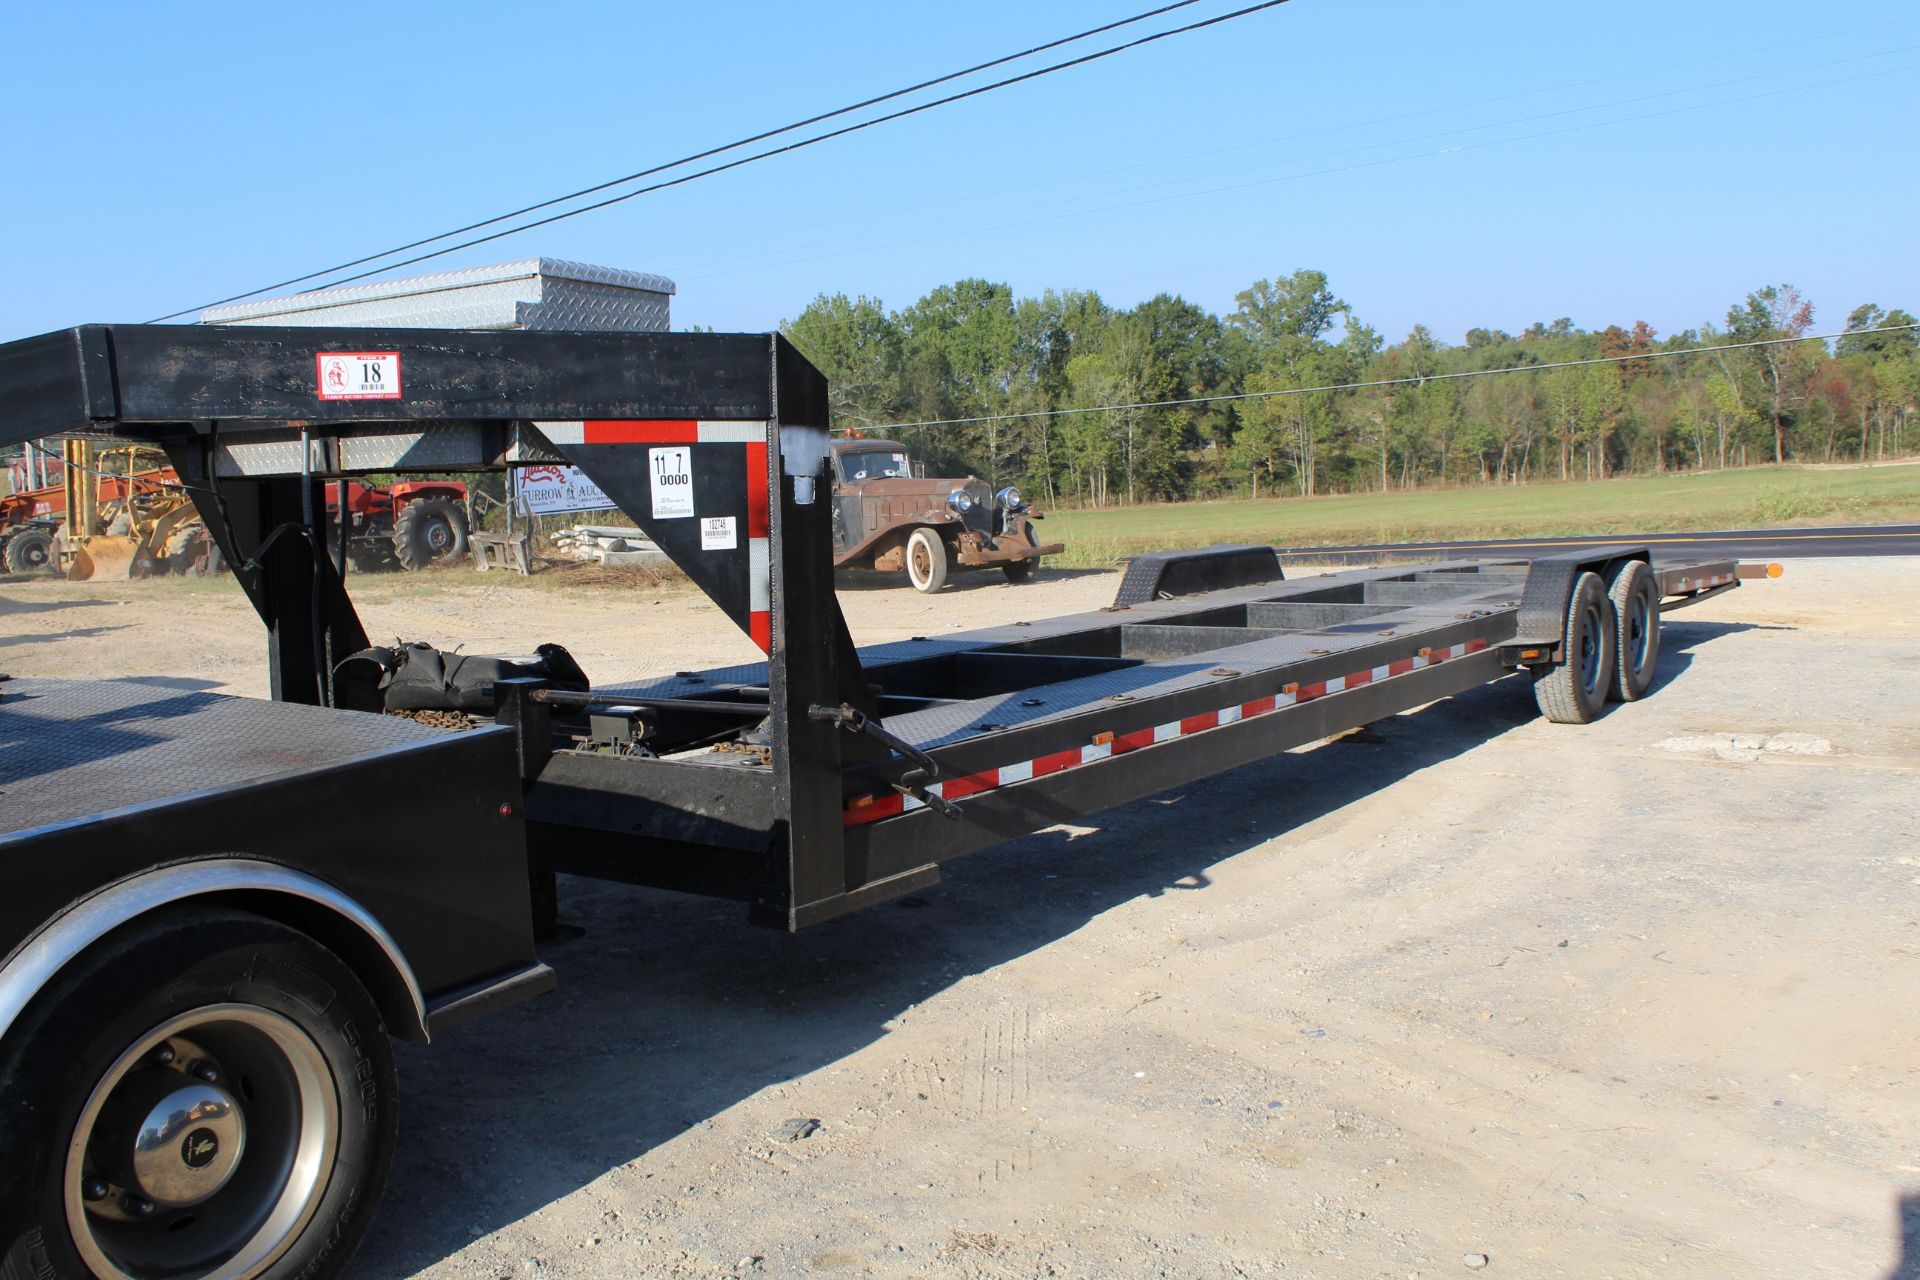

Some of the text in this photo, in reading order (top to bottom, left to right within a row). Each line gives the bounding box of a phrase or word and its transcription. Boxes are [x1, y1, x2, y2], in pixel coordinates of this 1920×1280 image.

[362, 362, 382, 383] 18
[655, 453, 682, 475] 11 7
[660, 474, 688, 486] 0000
[522, 486, 563, 501] FURROW
